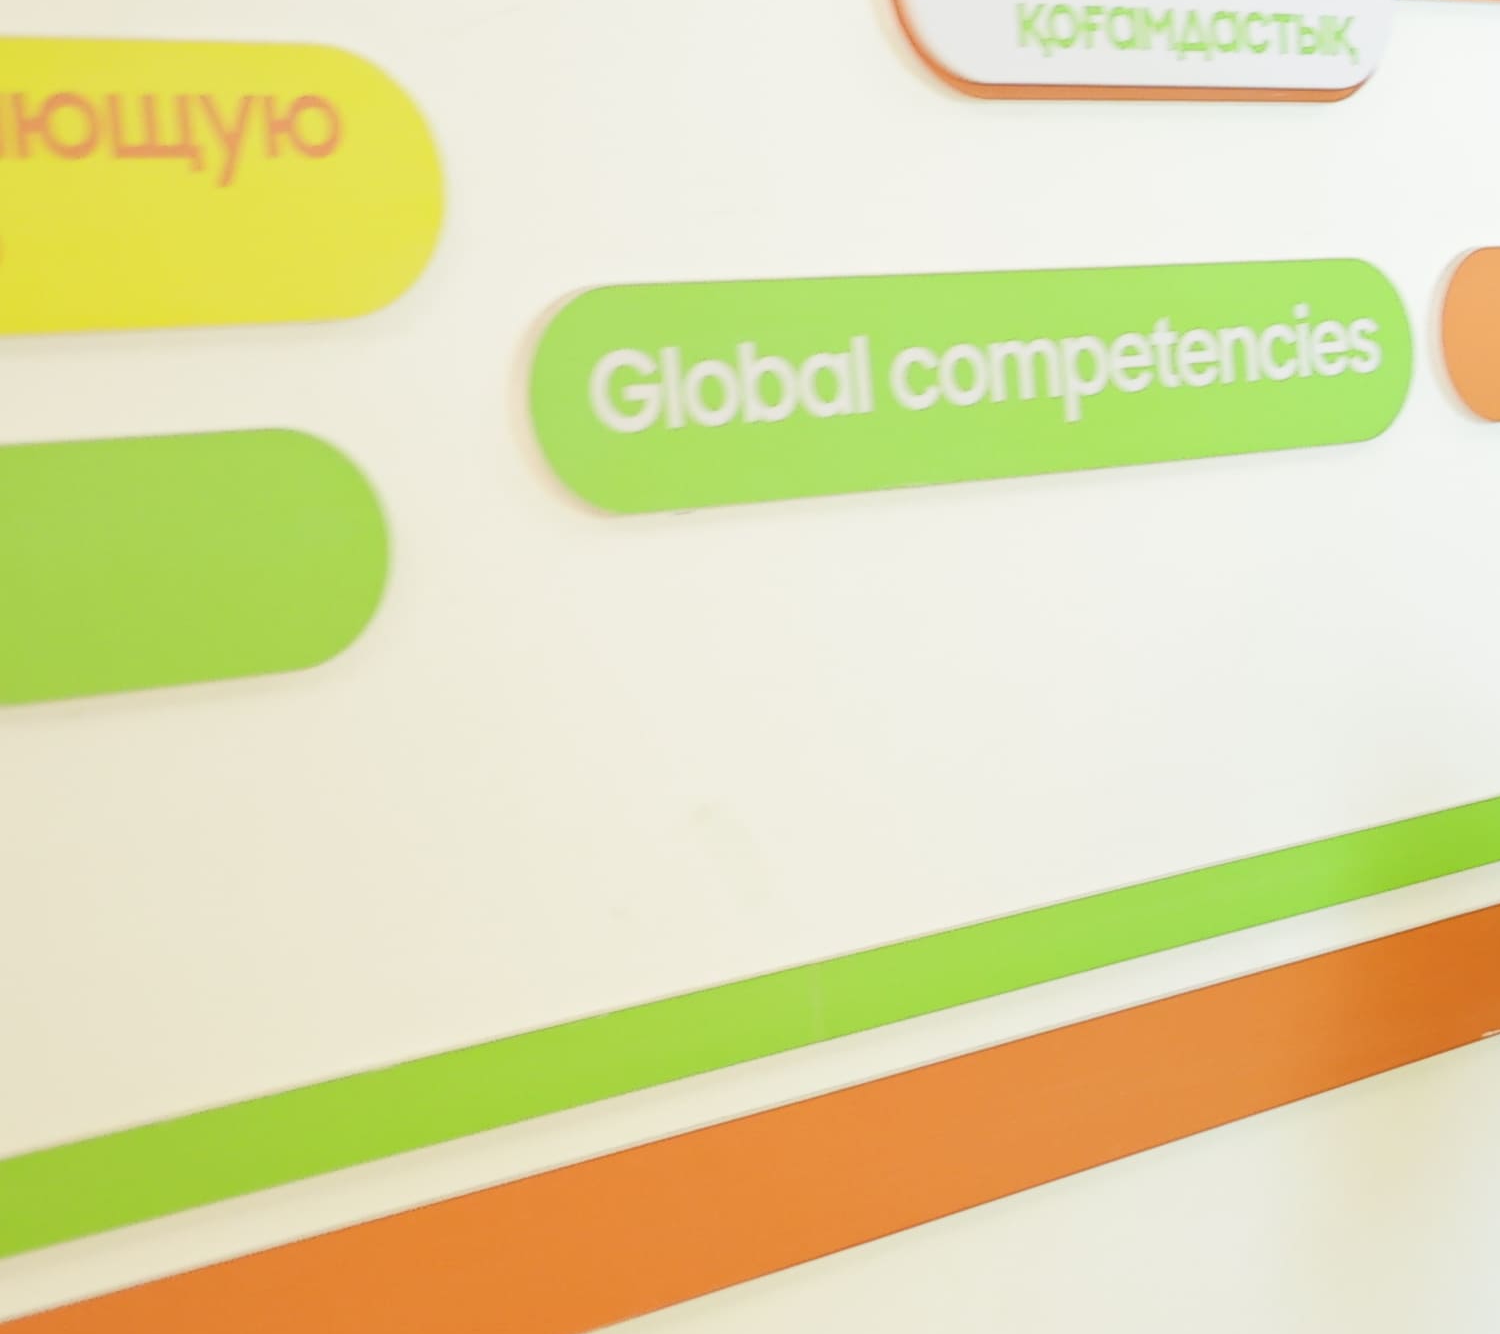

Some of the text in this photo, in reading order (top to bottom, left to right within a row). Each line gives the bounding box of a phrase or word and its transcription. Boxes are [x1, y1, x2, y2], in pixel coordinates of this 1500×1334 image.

[0, 91, 344, 188] ющую
[586, 302, 1382, 436] Global competencies
